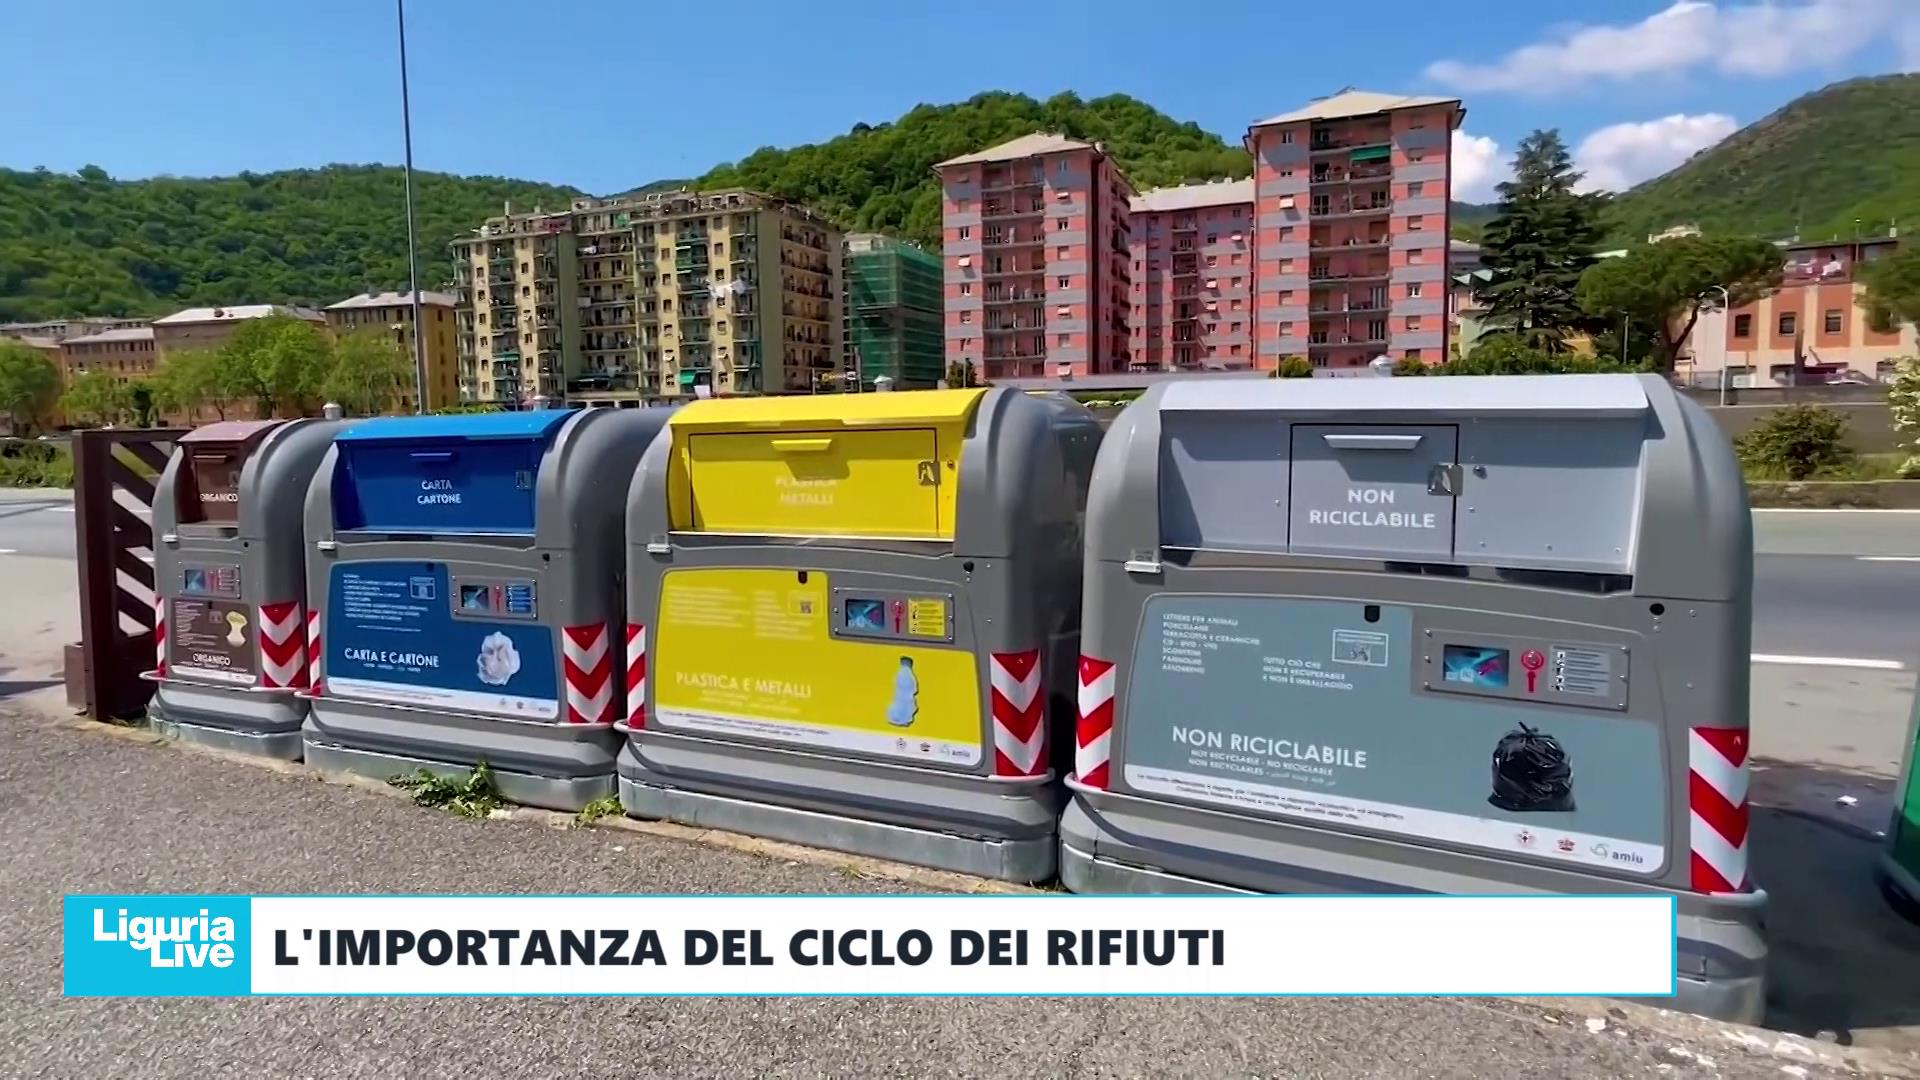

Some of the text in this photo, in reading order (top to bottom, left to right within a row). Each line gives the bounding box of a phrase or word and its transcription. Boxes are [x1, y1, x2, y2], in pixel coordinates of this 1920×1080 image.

[421, 479, 453, 490] CARTA
[417, 494, 462, 504] CARTONE
[780, 493, 834, 504] METALLI
[1348, 489, 1395, 504] NON
[1309, 510, 1436, 528] RICICLABILE
[344, 647, 378, 662] CARTA
[380, 651, 387, 662] E
[389, 651, 440, 668] CARTONE
[1263, 666, 1282, 674] NON
[676, 671, 739, 690] PLASTICA
[743, 678, 750, 691] E
[755, 680, 812, 698] METALLI
[1172, 725, 1367, 768] NON RICICLABILE
[1209, 751, 1260, 765] RECYCLABLE
[1266, 759, 1281, 769] NO
[1611, 850, 1644, 864] amiu
